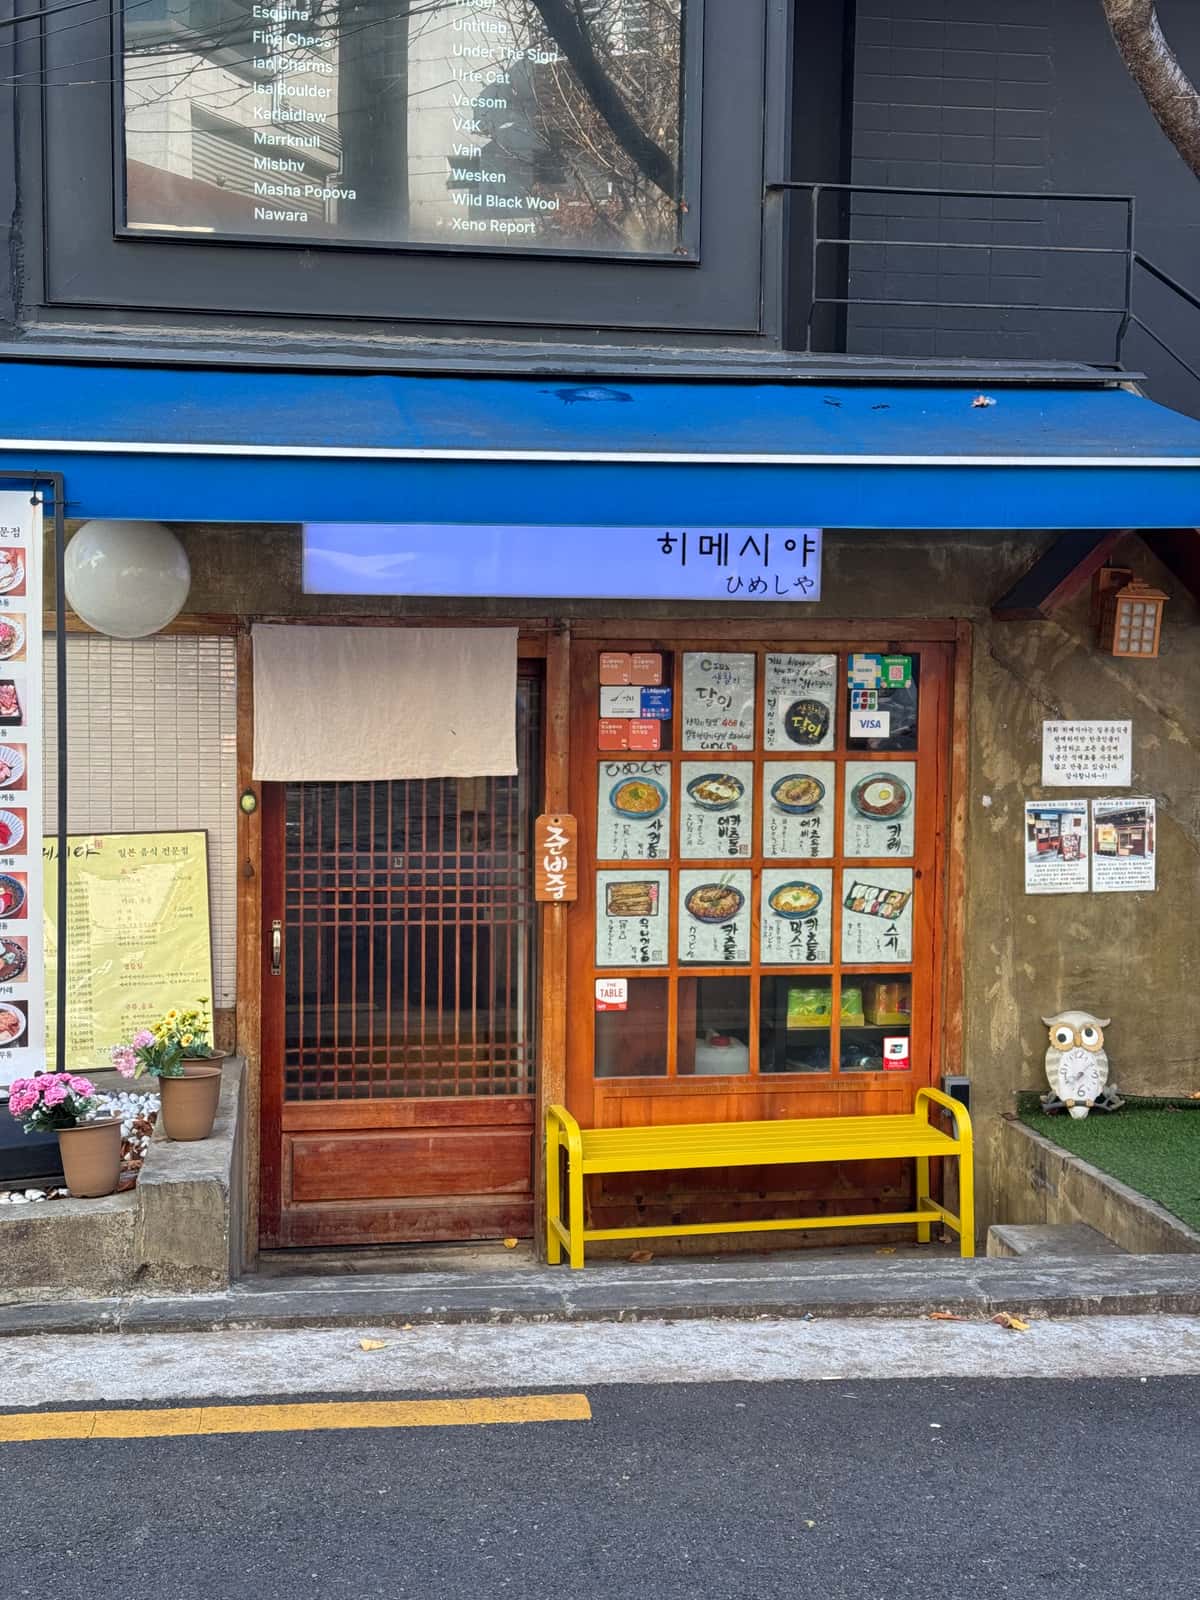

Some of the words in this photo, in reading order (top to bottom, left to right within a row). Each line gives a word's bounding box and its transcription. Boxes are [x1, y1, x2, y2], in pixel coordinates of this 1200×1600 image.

[252, 5, 309, 22] Esquina
[452, 19, 507, 34] Untitlab
[253, 31, 283, 44] Fine
[286, 33, 331, 47] Chaos
[452, 43, 494, 58] Under
[499, 46, 524, 60] The
[527, 48, 558, 64] Sign
[280, 57, 333, 73] Charms
[486, 71, 511, 84] Cat
[252, 81, 274, 94] Isa
[278, 83, 332, 98] Boulder
[452, 93, 508, 109] Vacsom
[452, 118, 481, 131] V4K
[253, 132, 320, 147] Marrknull
[253, 157, 305, 172] Misbhv
[452, 168, 506, 183] Wesken
[253, 182, 301, 196] Masha
[304, 185, 357, 200] Popova
[452, 193, 482, 207] Wild
[486, 194, 523, 209] Black
[525, 196, 560, 211] Wool
[254, 207, 308, 222] Nawara
[452, 217, 487, 232] Xeno
[490, 219, 536, 236] Report
[656, 531, 816, 567] 히메시야
[725, 575, 814, 595] ひめしや
[696, 688, 732, 711] 달인
[860, 720, 881, 729] VISA
[118, 848, 137, 858] 일본
[140, 848, 158, 857] 음식
[162, 846, 189, 857] 전문점
[543, 825, 570, 900] 준비중
[882, 922, 901, 952] 스시
[600, 988, 623, 998] TABLE
[1077, 1084, 1086, 1097] 6
